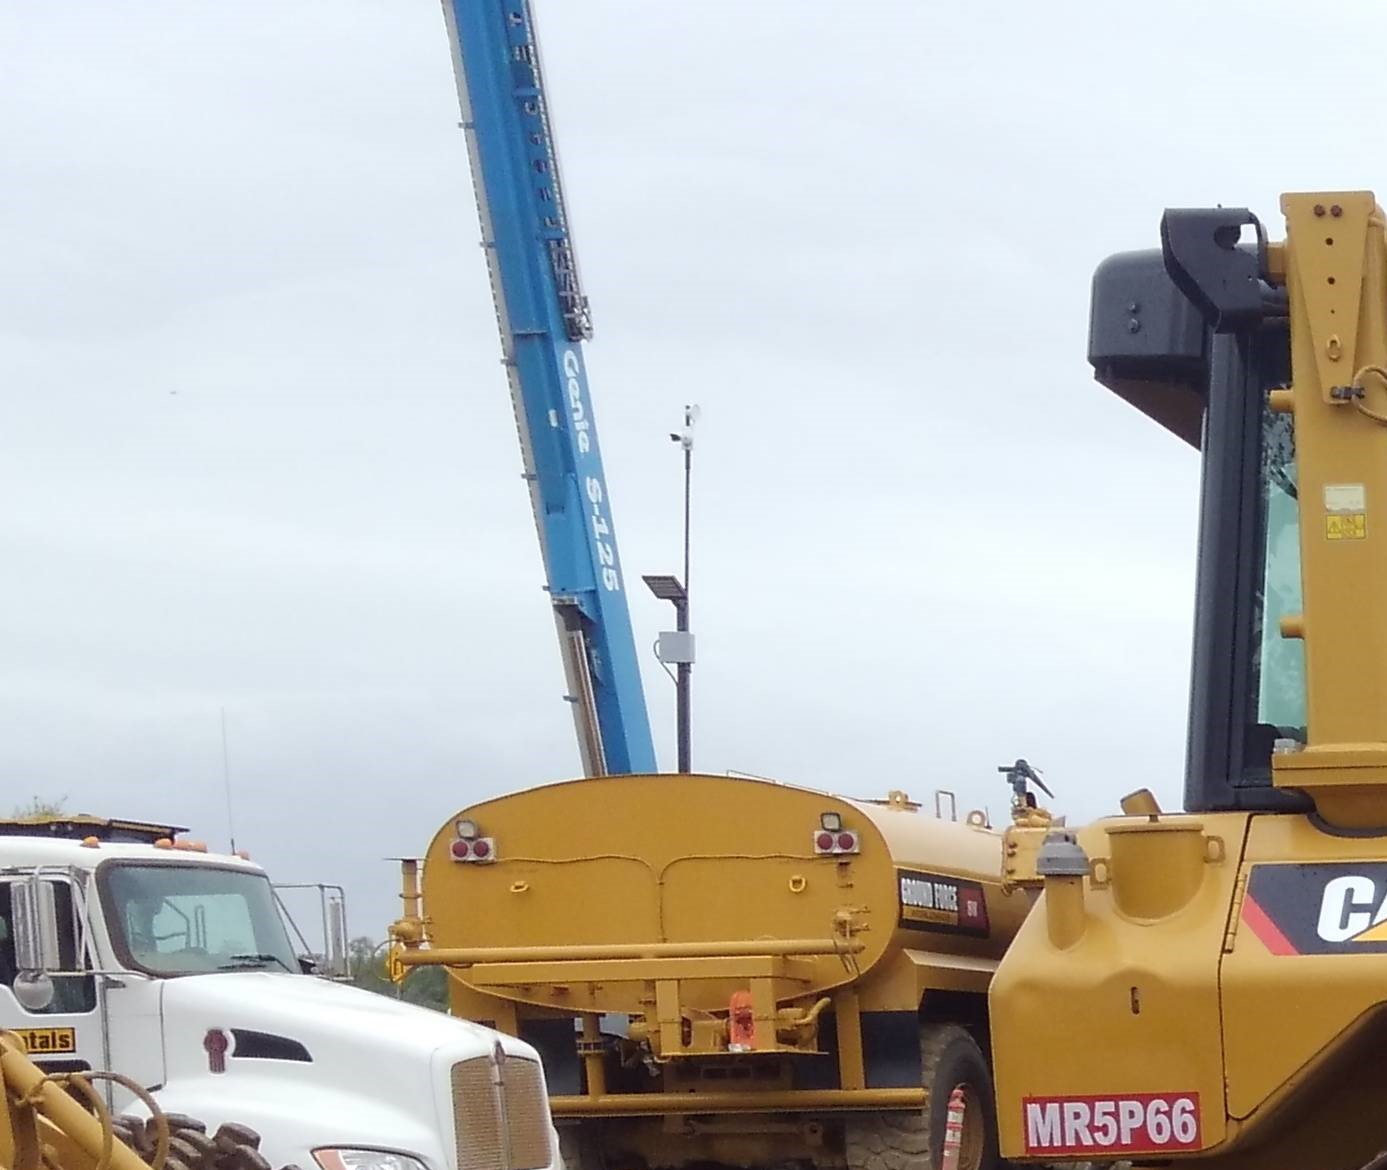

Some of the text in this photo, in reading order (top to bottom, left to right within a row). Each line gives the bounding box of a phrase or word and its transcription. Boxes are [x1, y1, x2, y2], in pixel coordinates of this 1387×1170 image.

[564, 350, 619, 592] Genie S-125
[1026, 1098, 1197, 1147] MR5P66
